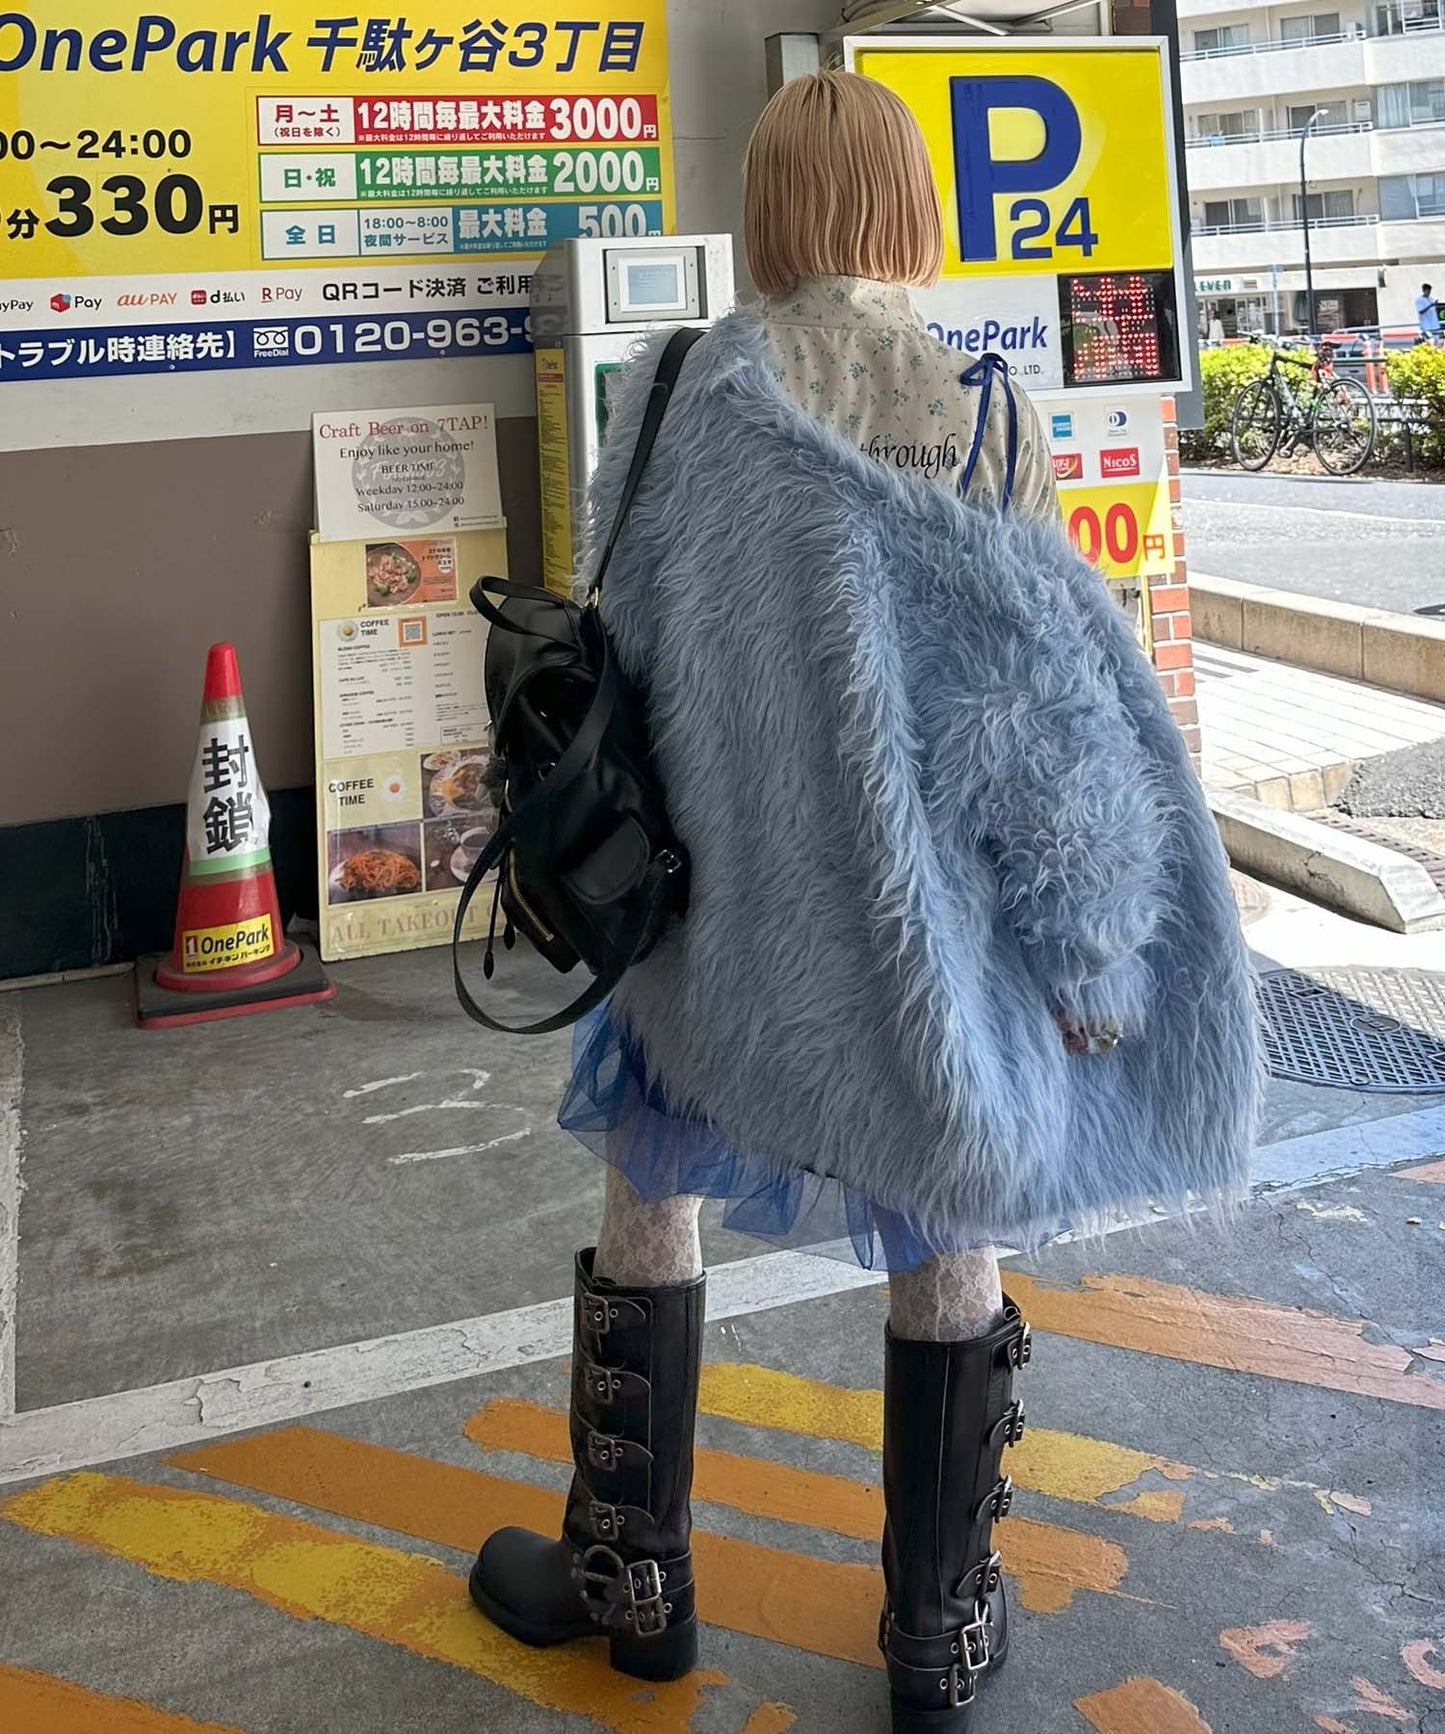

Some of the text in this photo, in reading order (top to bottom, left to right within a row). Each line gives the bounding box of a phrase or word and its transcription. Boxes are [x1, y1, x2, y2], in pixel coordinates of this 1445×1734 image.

[0, 13, 645, 73] OnePark 千駄ヶ谷3丁目
[949, 75, 1099, 263] P 24
[459, 207, 547, 240] 最大料金
[364, 233, 449, 248] 夜間サービス
[0, 299, 34, 313] yPay
[74, 296, 102, 311] Pay
[117, 294, 148, 306] au
[149, 293, 178, 305] PAY
[276, 287, 302, 302] Pay
[322, 278, 466, 301] QRコード決済
[253, 349, 289, 358] FreeDial
[319, 416, 489, 440] Craft Beer on 7TAP!
[339, 441, 474, 461] Enjoy like your home!
[355, 484, 403, 497] Weekday
[357, 500, 405, 513] Saturday
[359, 618, 390, 628] COFFEE
[361, 628, 378, 637] TIME
[202, 734, 254, 855] 封鎖
[328, 778, 375, 793] COFFEE
[339, 794, 366, 807] TIME
[331, 922, 371, 943] ALL
[377, 905, 478, 935] TAKEOT
[201, 923, 269, 955] OnePark
